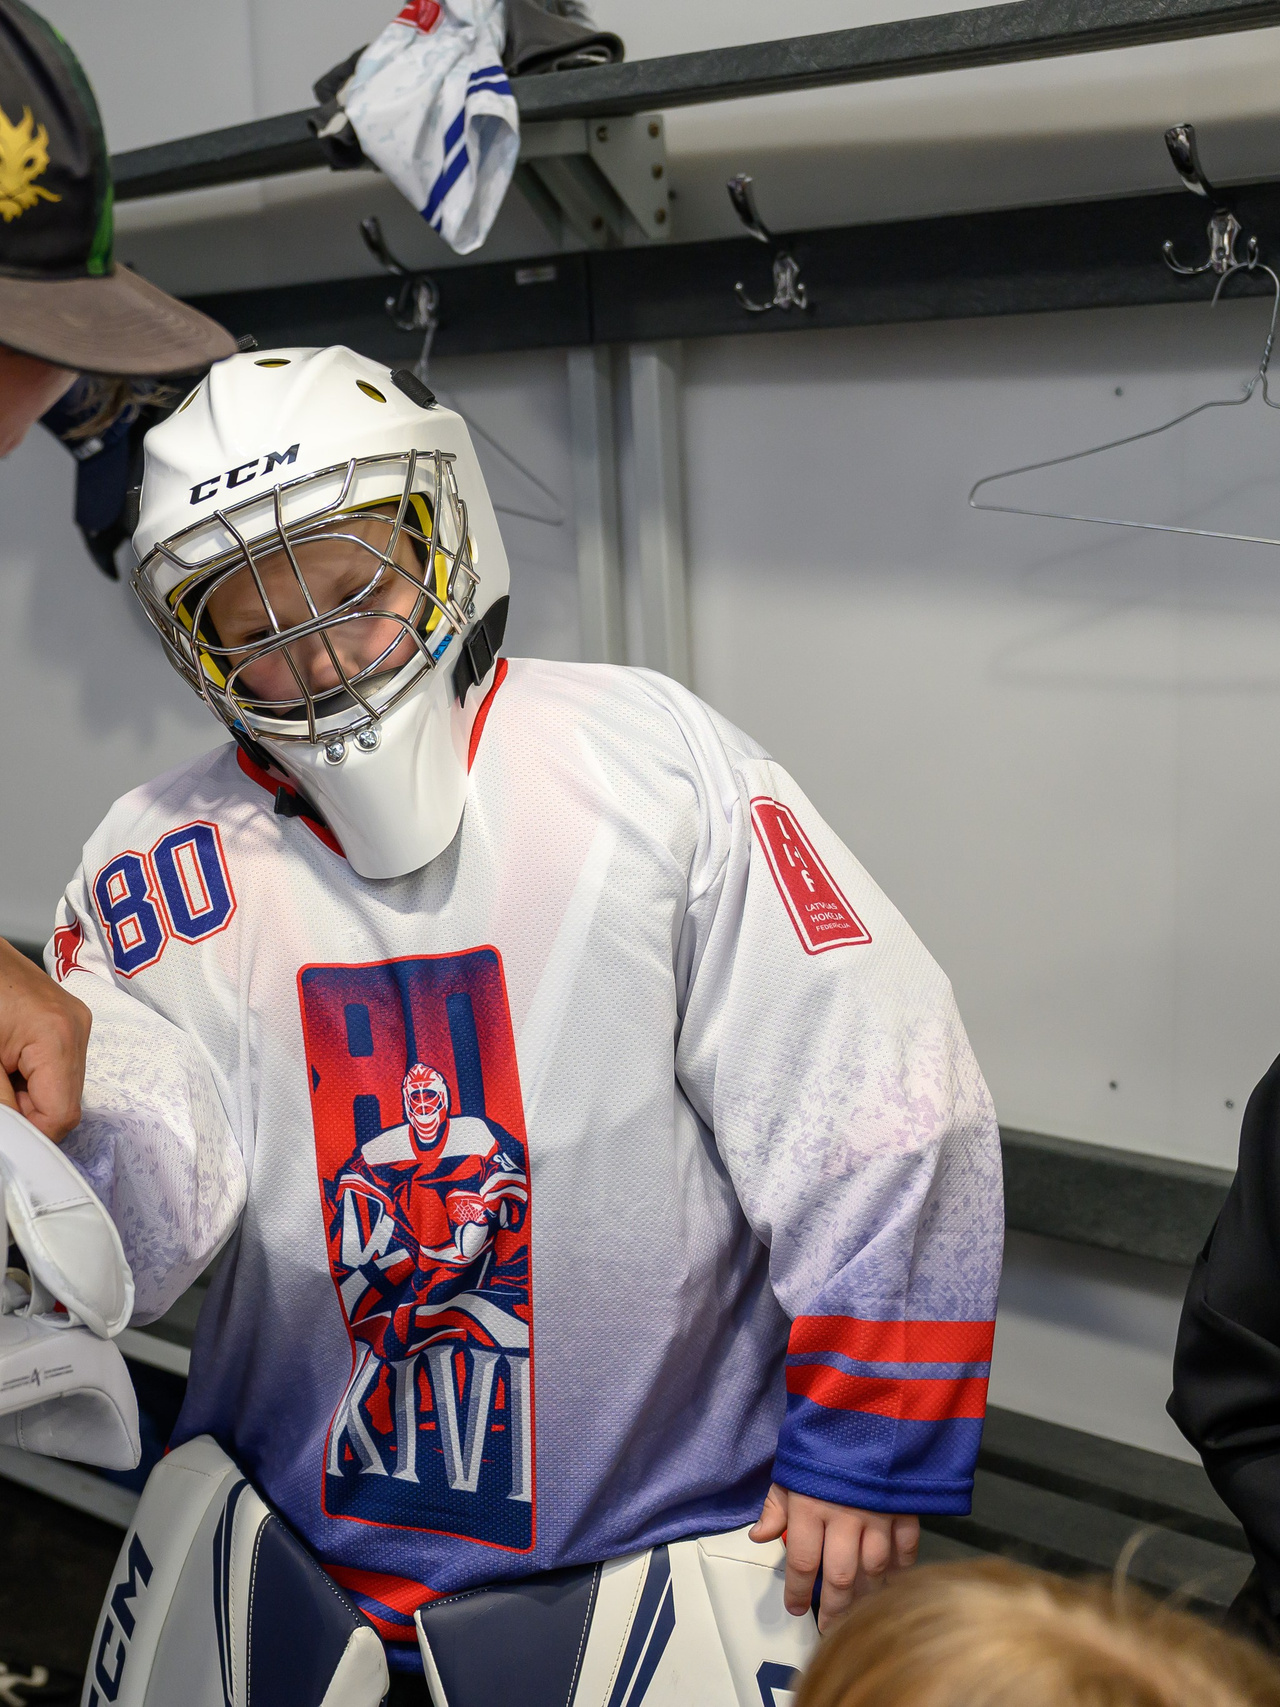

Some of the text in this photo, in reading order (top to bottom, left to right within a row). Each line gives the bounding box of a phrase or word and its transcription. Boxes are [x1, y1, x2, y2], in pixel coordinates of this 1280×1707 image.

[188, 442, 301, 506] CCM
[92, 819, 238, 980] 80
[324, 1341, 531, 1502] KIVI
[86, 1530, 155, 1707] CM
